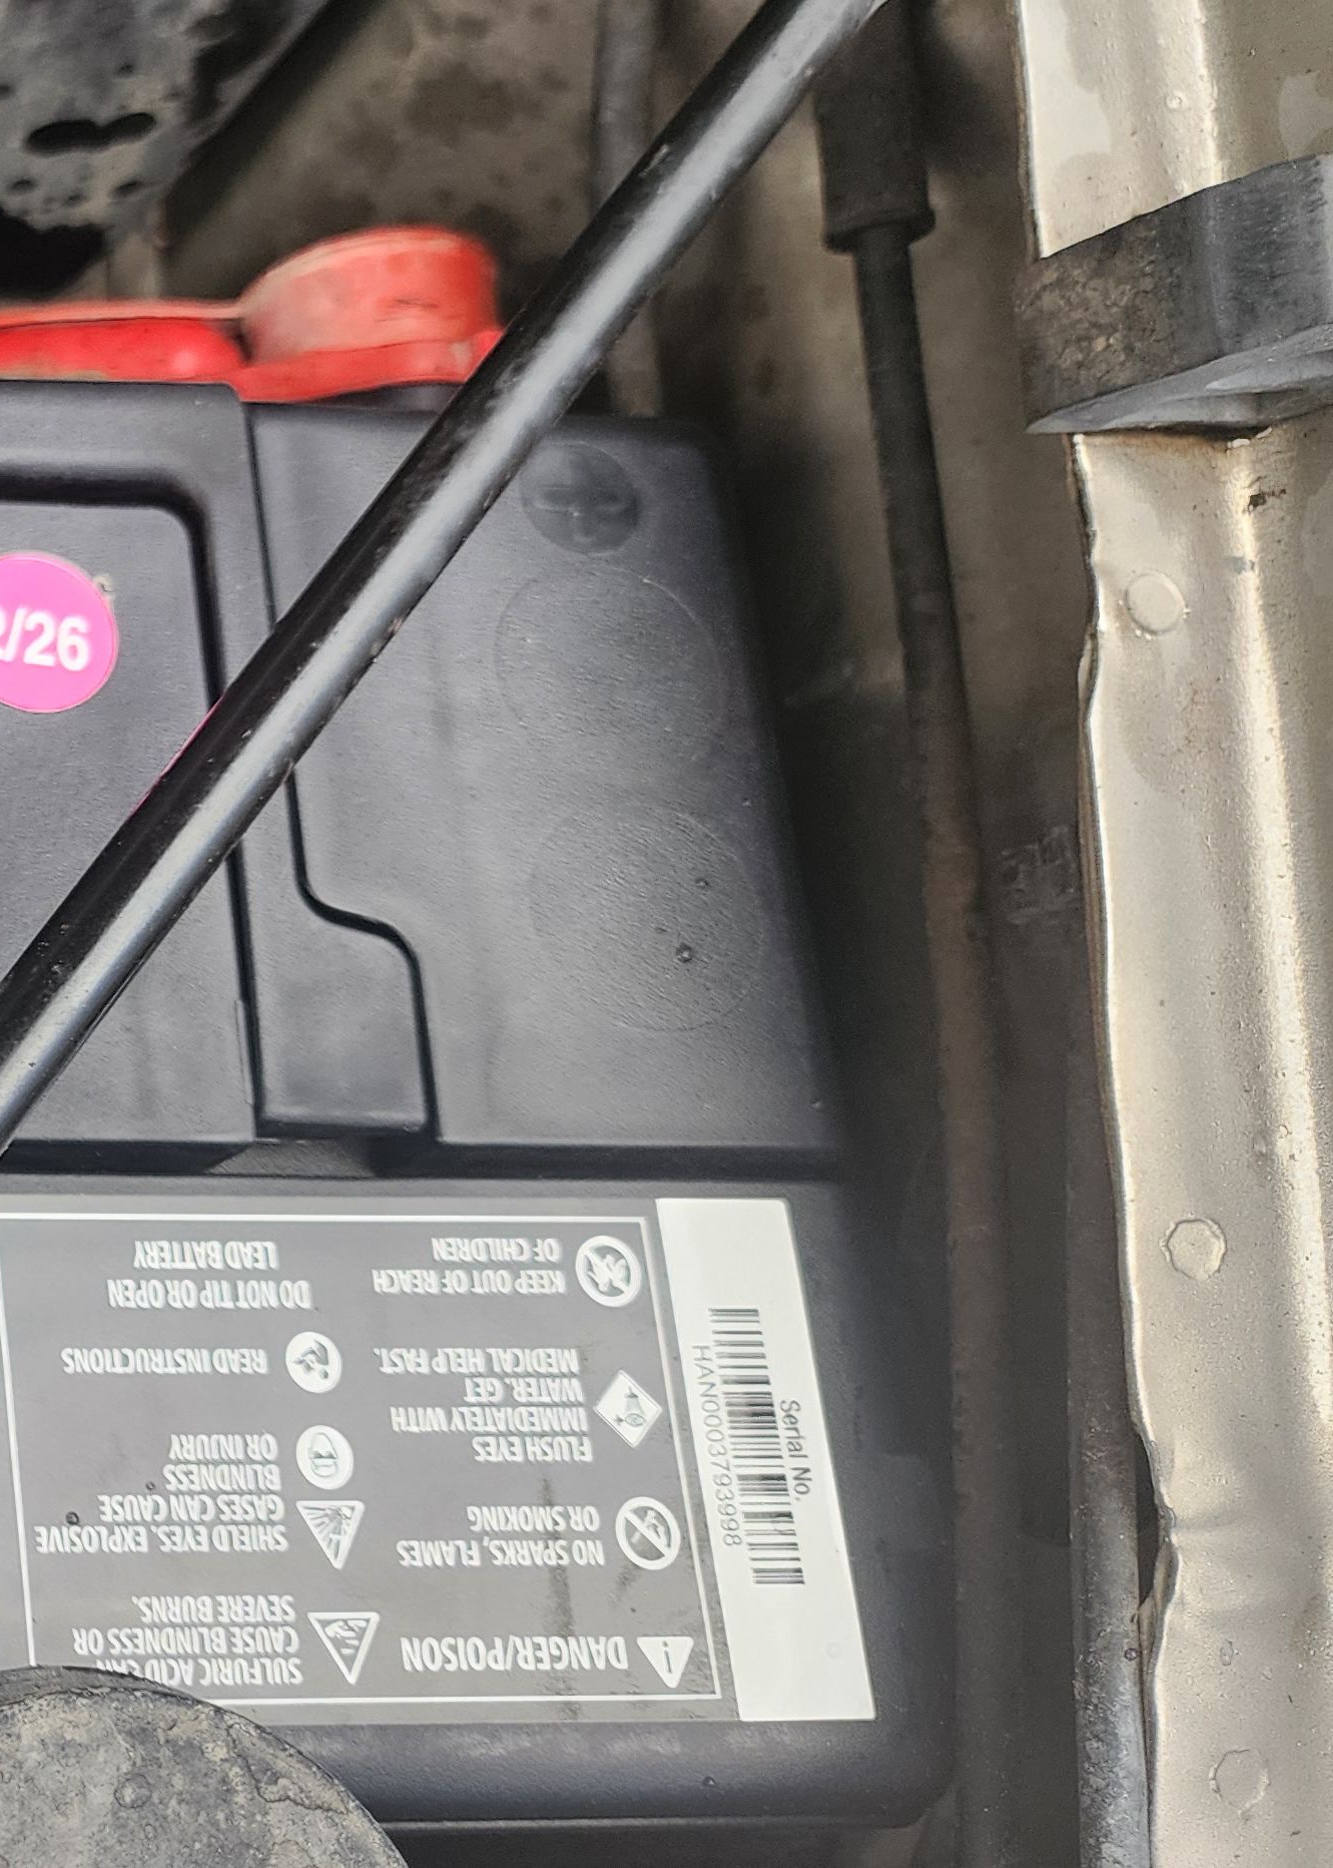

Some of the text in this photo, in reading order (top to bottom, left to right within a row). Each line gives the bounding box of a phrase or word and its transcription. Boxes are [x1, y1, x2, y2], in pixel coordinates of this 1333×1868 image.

[133, 1241, 279, 1269] LEAD BATTERY
[431, 1238, 560, 1263] OF CHILDREN
[106, 1279, 313, 1310] DO NOT TIP OR OPEN
[371, 1269, 566, 1295] KEEP OUT OF REACH
[60, 1347, 269, 1374] READ INSTRUCTIONS
[373, 1348, 580, 1374] MEDICAL HELP FAST.
[463, 1377, 584, 1403] WATER. GET
[390, 1407, 588, 1433] IMMEDIATELY WITH
[168, 1433, 279, 1461] OR INJURY
[472, 1436, 593, 1463] FLUSH EYES
[780, 1400, 813, 1502] Serial No.
[162, 1464, 282, 1491] BLINDNESS
[97, 1494, 285, 1523] GASES CAN CAUSE
[466, 1506, 600, 1532] OR SMOKING
[34, 1524, 289, 1554] SHIELD EYES. EXPLOSIVE
[396, 1536, 605, 1566] NO SPARKS, FLAMES
[131, 1595, 295, 1624] SEVERE BURNS.
[71, 1626, 300, 1656] CAUSE BLINDNESS OR
[400, 1635, 628, 1672] DANGER/POISON
[144, 1658, 194, 1686] ACID
[199, 1657, 303, 1686] SULFURIC
